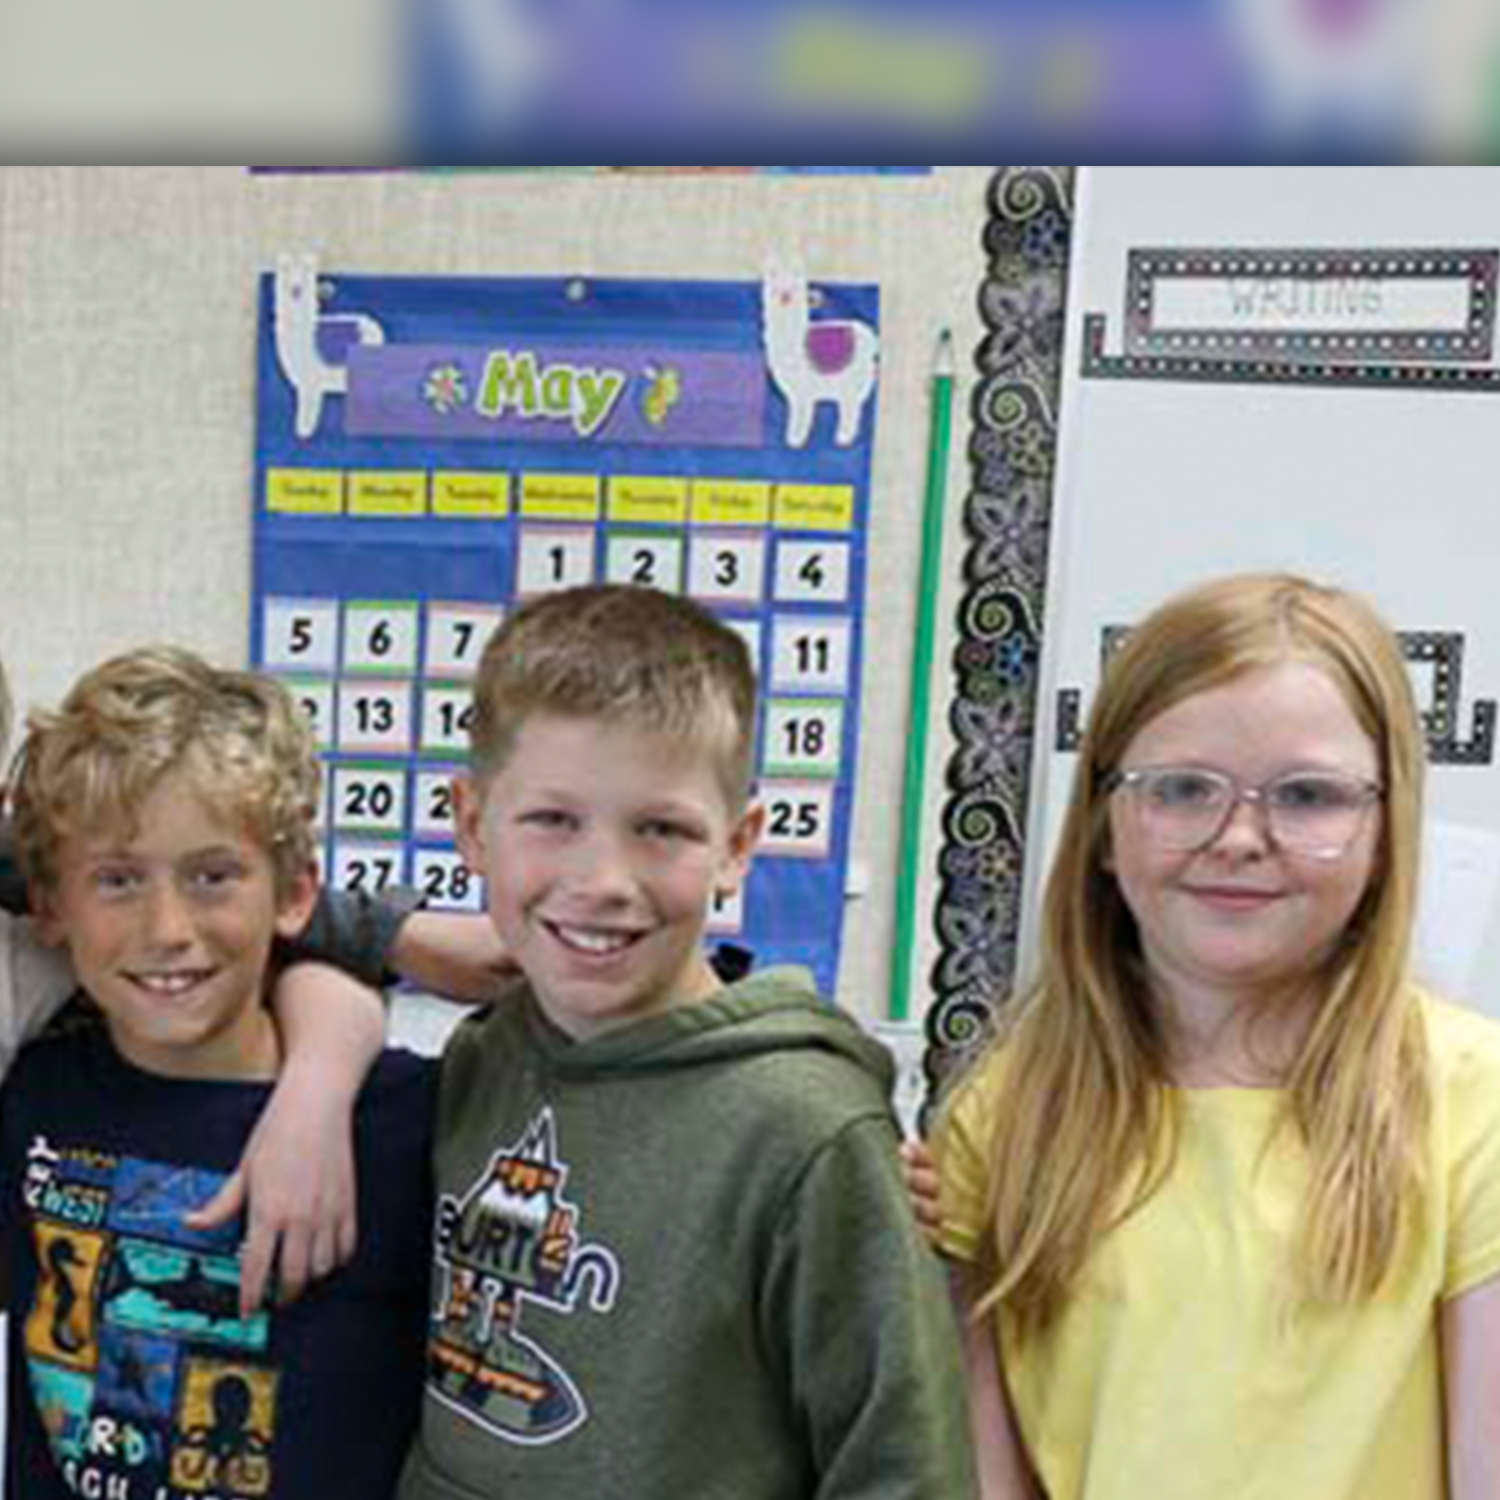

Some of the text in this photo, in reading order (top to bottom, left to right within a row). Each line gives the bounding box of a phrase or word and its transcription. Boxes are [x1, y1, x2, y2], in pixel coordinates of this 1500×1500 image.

[475, 350, 621, 436] May
[550, 546, 823, 588] 1 2 3 4
[289, 619, 829, 672] 5 6 7 11
[354, 698, 393, 732] 13
[783, 719, 825, 755] 18
[345, 782, 394, 818] 20
[769, 801, 818, 837] 25
[346, 860, 470, 900] 27 28
